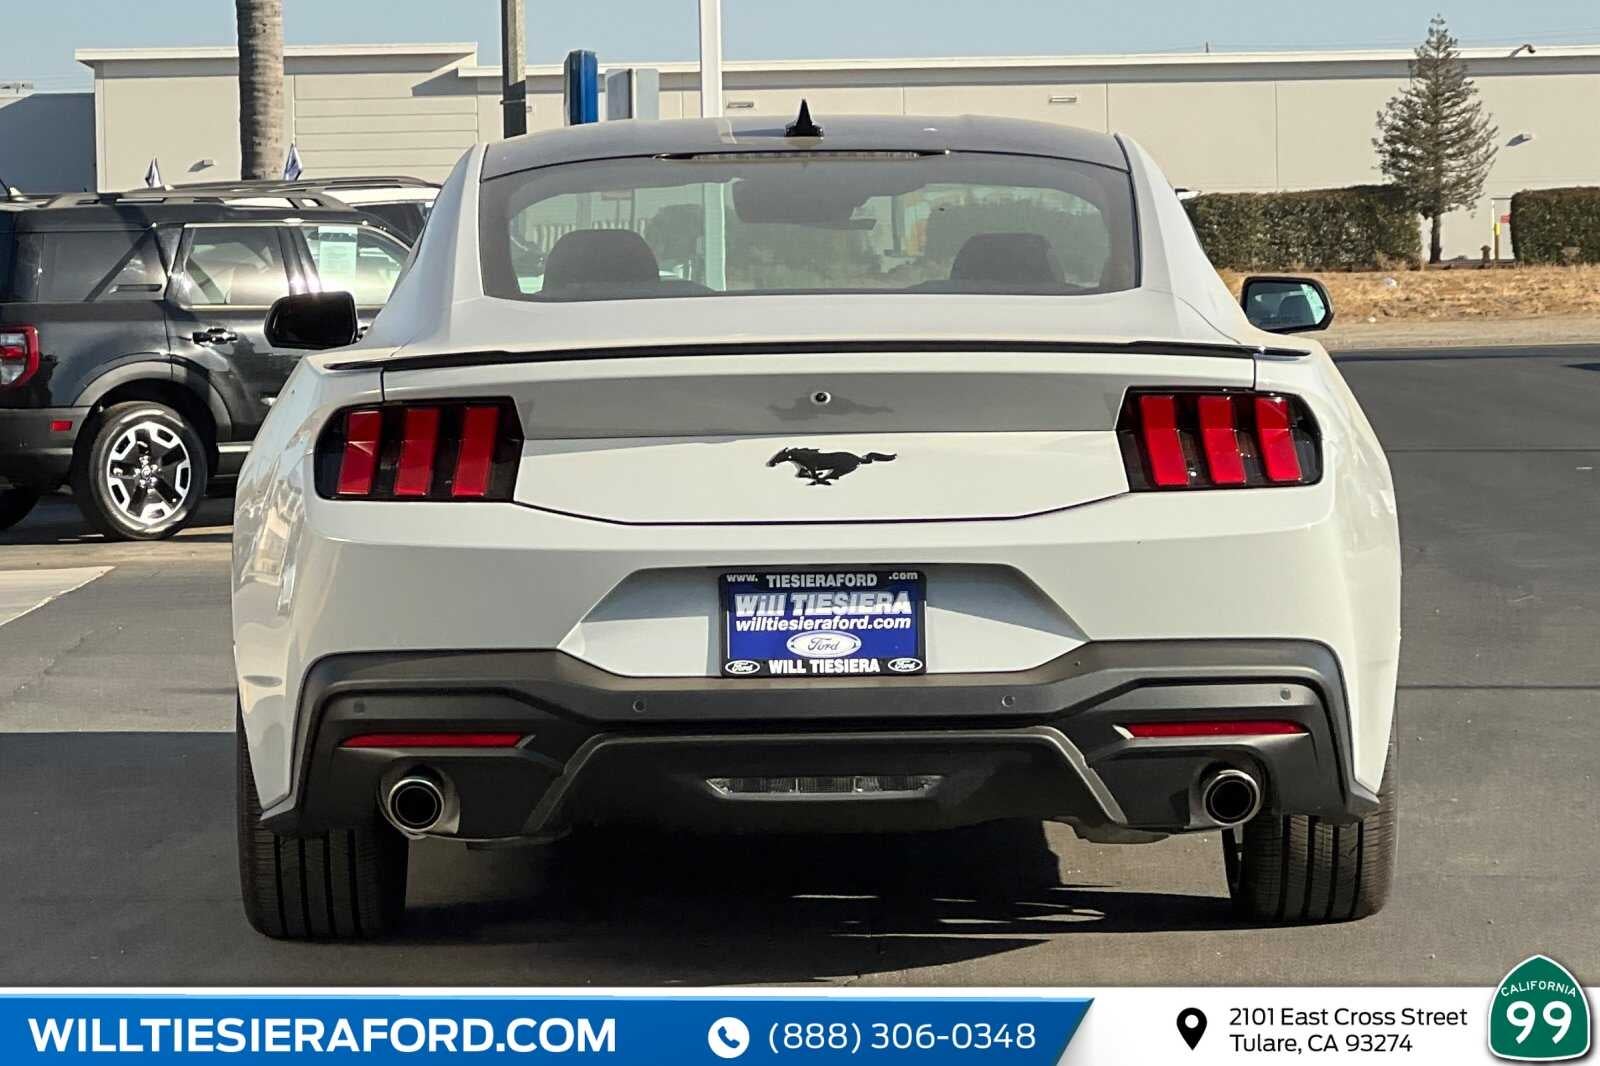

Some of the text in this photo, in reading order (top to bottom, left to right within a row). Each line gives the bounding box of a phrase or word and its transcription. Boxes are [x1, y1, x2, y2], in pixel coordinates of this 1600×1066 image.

[766, 574, 878, 588] TIESIERAFORD
[888, 571, 918, 580] .com
[735, 591, 912, 617] Will TIESIERA
[736, 615, 911, 632] willtiesieraford.com
[807, 637, 841, 651] Ford
[732, 661, 753, 672] Ford
[768, 658, 880, 674] WILL TIESIERA
[894, 660, 916, 670] Ford
